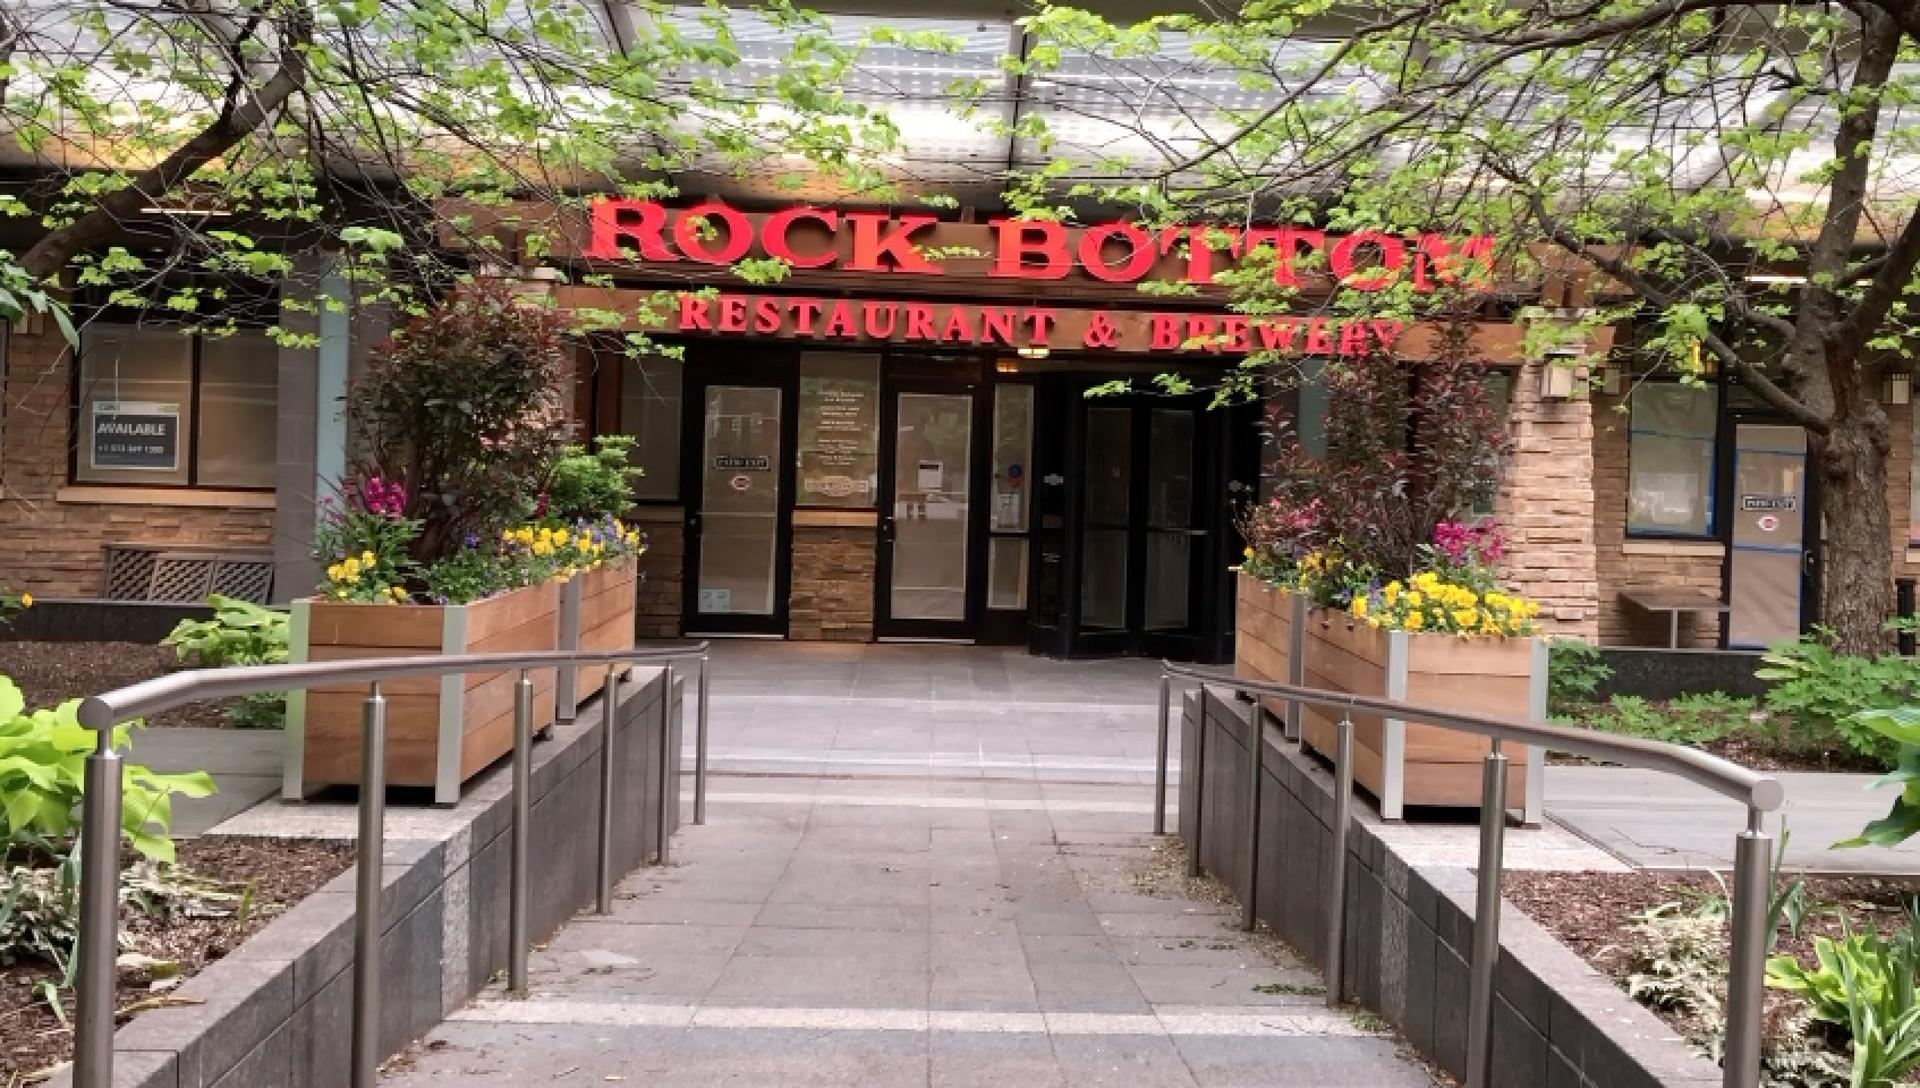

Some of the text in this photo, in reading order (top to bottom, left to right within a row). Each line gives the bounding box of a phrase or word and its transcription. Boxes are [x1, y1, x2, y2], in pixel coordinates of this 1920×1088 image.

[583, 199, 1496, 293] ROCK BOTTOM
[678, 293, 1403, 356] RESTAURANT & BREWERY
[97, 423, 166, 436] AVAILABLE
